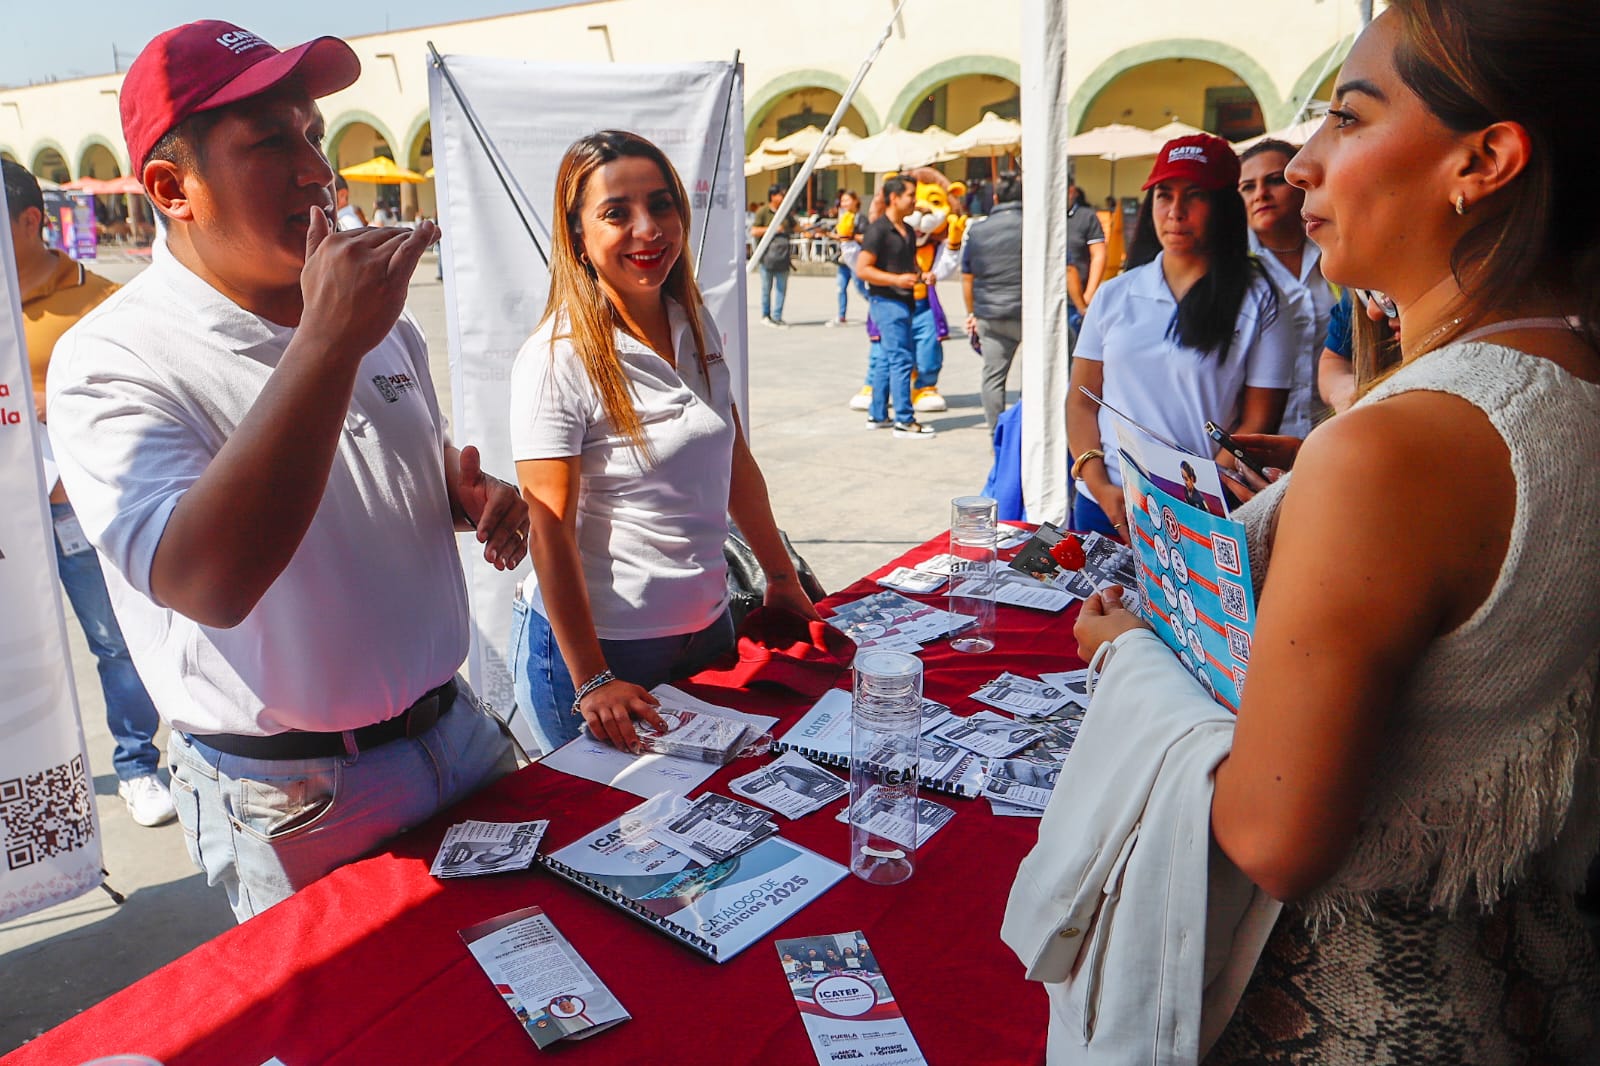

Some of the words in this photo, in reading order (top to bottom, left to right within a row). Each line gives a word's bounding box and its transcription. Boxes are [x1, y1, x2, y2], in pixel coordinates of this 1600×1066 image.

[801, 713, 832, 738] ICATEP
[878, 766, 918, 785] ICAT
[700, 889, 763, 932] CATÁLOGO
[764, 878, 780, 892] DE
[710, 901, 767, 939] SERVICIOS
[765, 875, 809, 906] 2025
[819, 988, 859, 998] ICATEP
[831, 1052, 864, 1061] PUEBLA
